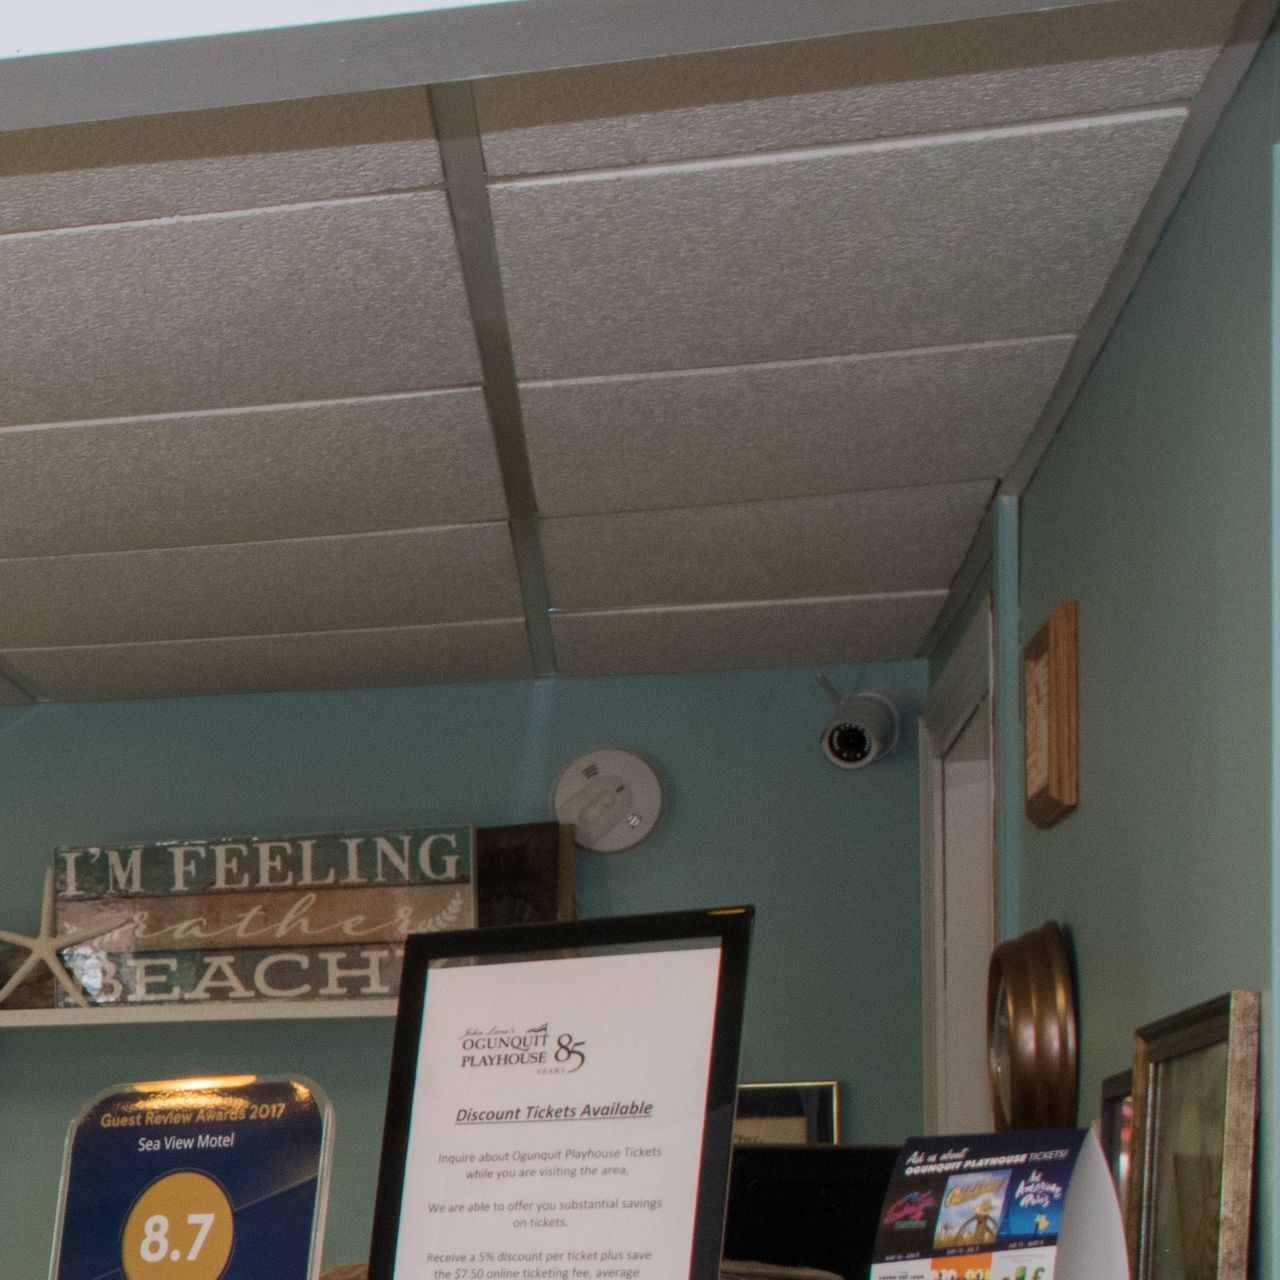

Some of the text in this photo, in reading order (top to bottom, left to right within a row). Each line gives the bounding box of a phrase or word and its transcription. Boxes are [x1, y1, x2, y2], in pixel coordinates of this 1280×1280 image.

[61, 832, 460, 897] I'M FEELING
[132, 892, 416, 940] rather
[462, 1034, 550, 1050] OGUNQUIT
[461, 1052, 548, 1067] PLAYHOUSE
[554, 1033, 586, 1073] 85
[100, 1103, 286, 1128] Guest Review Awards 2017
[456, 1101, 654, 1122] Discount Tickets Available
[138, 1133, 235, 1151] Sea View Motel
[438, 1147, 662, 1164] Inquire about Ogunquit Playhouse Tickets
[466, 1166, 629, 1180] while you are visiting the area.
[904, 1160, 962, 1176] OGUNQUIT
[963, 1154, 1029, 1168] PLAYHOUSE
[428, 1199, 662, 1213] We are able to offer you substantial savings
[513, 1217, 568, 1228] on tickets.
[140, 1213, 215, 1263] 8.7
[426, 1252, 467, 1263] Receive
[479, 1251, 495, 1262] 5%
[497, 1251, 543, 1262] discount
[545, 1253, 564, 1263] per
[567, 1250, 598, 1261] ticket
[600, 1250, 624, 1262] plus
[626, 1252, 652, 1260] save
[434, 1267, 640, 1280] the $7.50 online ticketing fee, average
